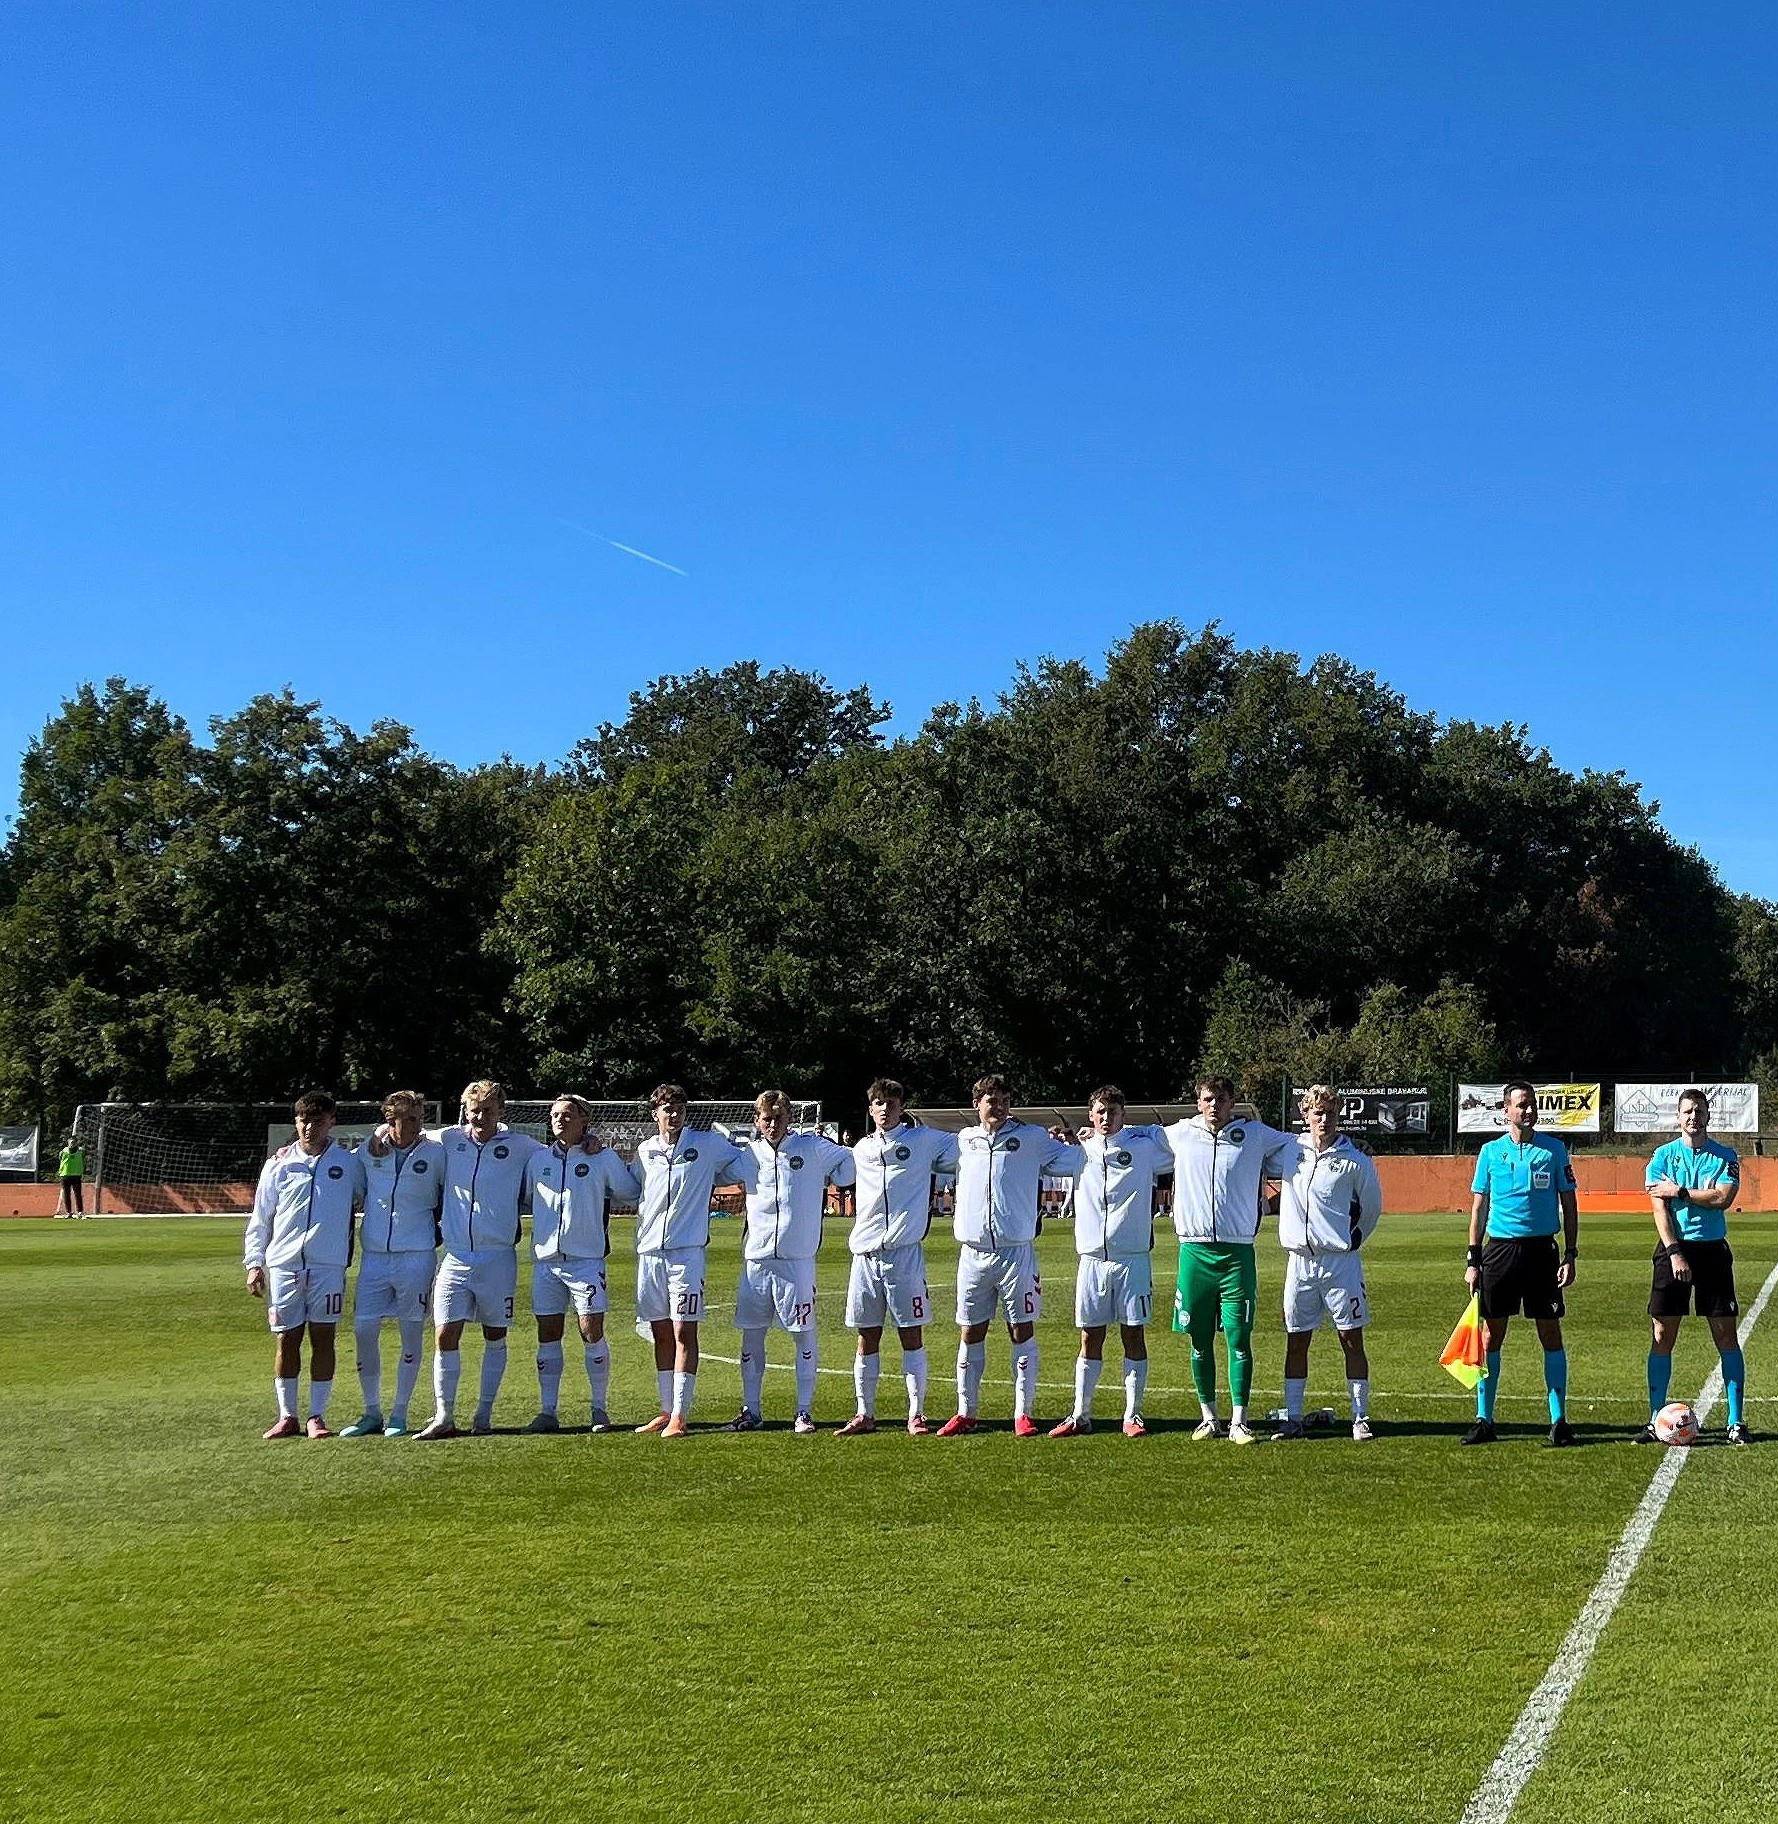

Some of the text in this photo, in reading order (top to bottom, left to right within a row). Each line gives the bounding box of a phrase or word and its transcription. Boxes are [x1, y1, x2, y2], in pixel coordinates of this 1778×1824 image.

[1538, 1094, 1592, 1111] IMEX
[325, 1293, 342, 1316] 10
[418, 1292, 429, 1314] 4
[505, 1296, 514, 1319] 3
[676, 1293, 699, 1315] 20
[912, 1296, 924, 1319] 8
[1024, 1292, 1035, 1315] 6
[1244, 1299, 1250, 1323] 1
[1350, 1297, 1362, 1320] 2
